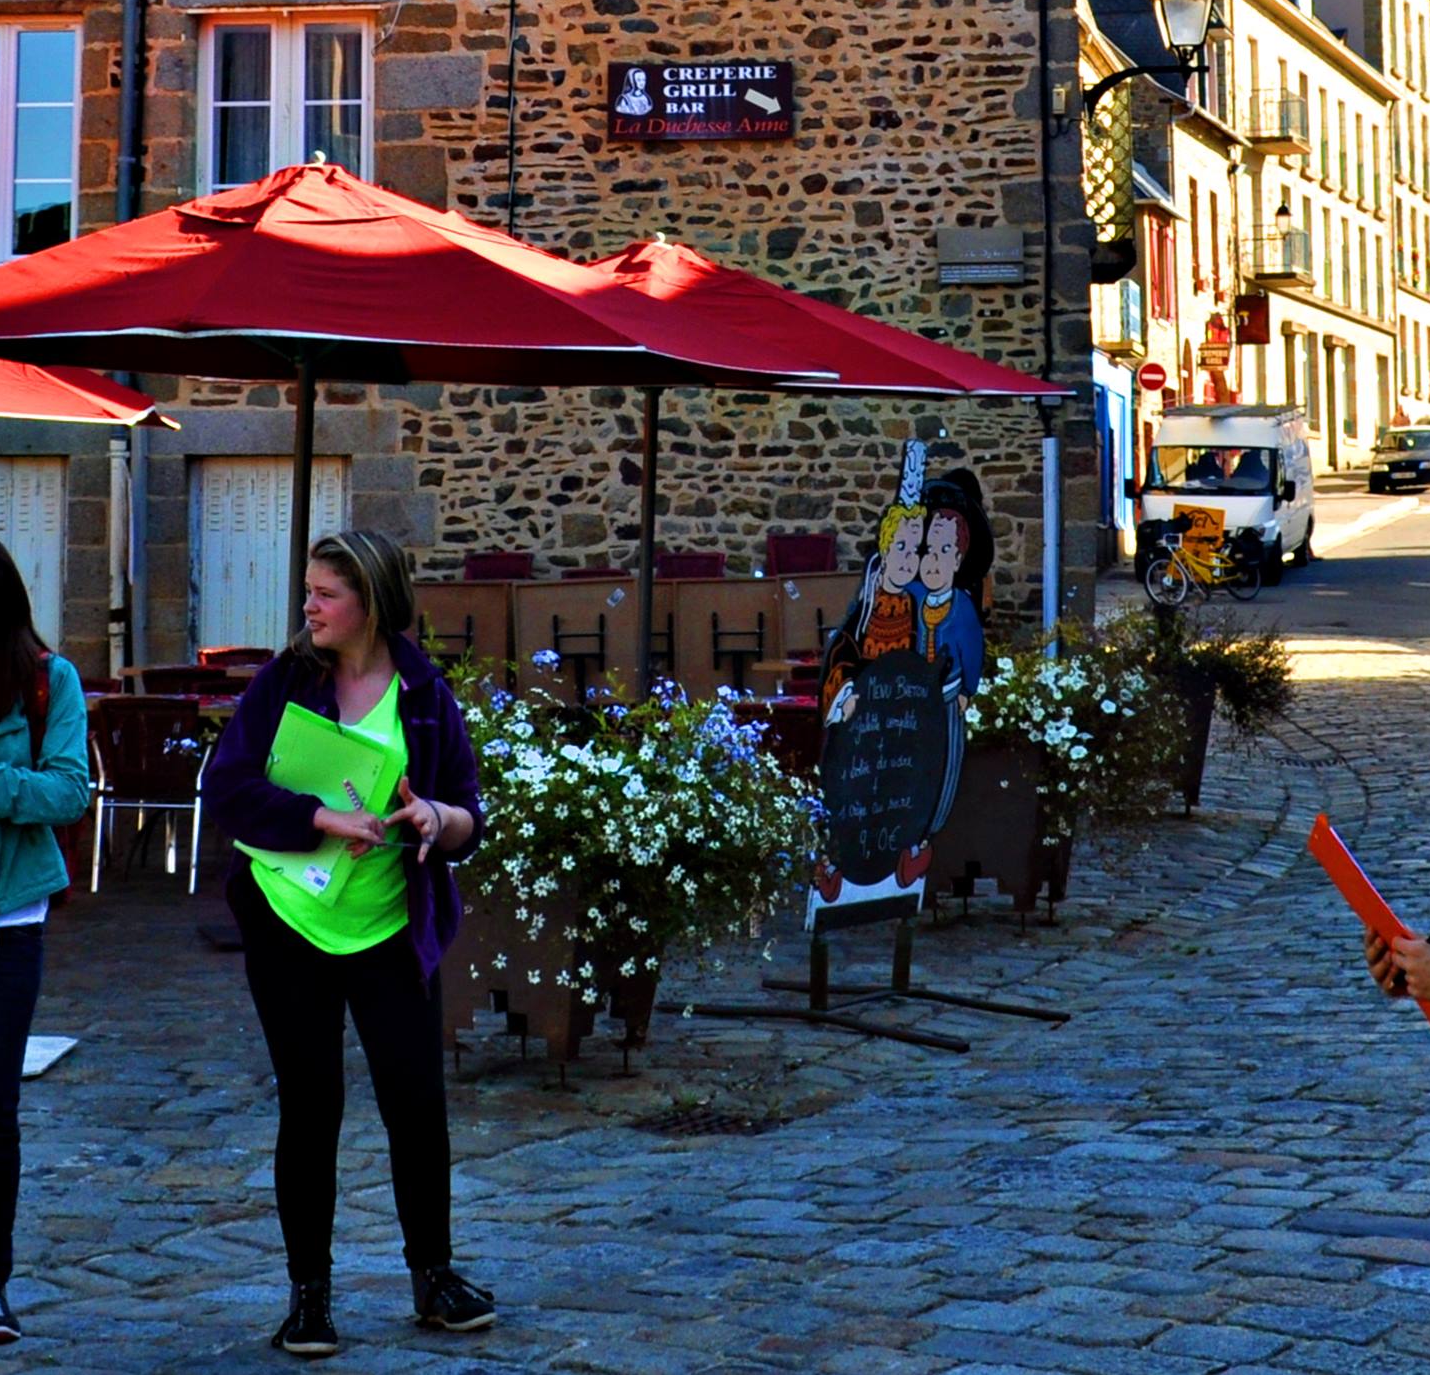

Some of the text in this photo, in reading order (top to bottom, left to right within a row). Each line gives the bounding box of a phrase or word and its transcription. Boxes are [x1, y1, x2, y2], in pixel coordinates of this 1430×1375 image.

[662, 66, 777, 82] CREPERIE
[662, 84, 737, 98] GRILL
[665, 103, 705, 114] BAR
[613, 114, 788, 134] La Duchesse Anne
